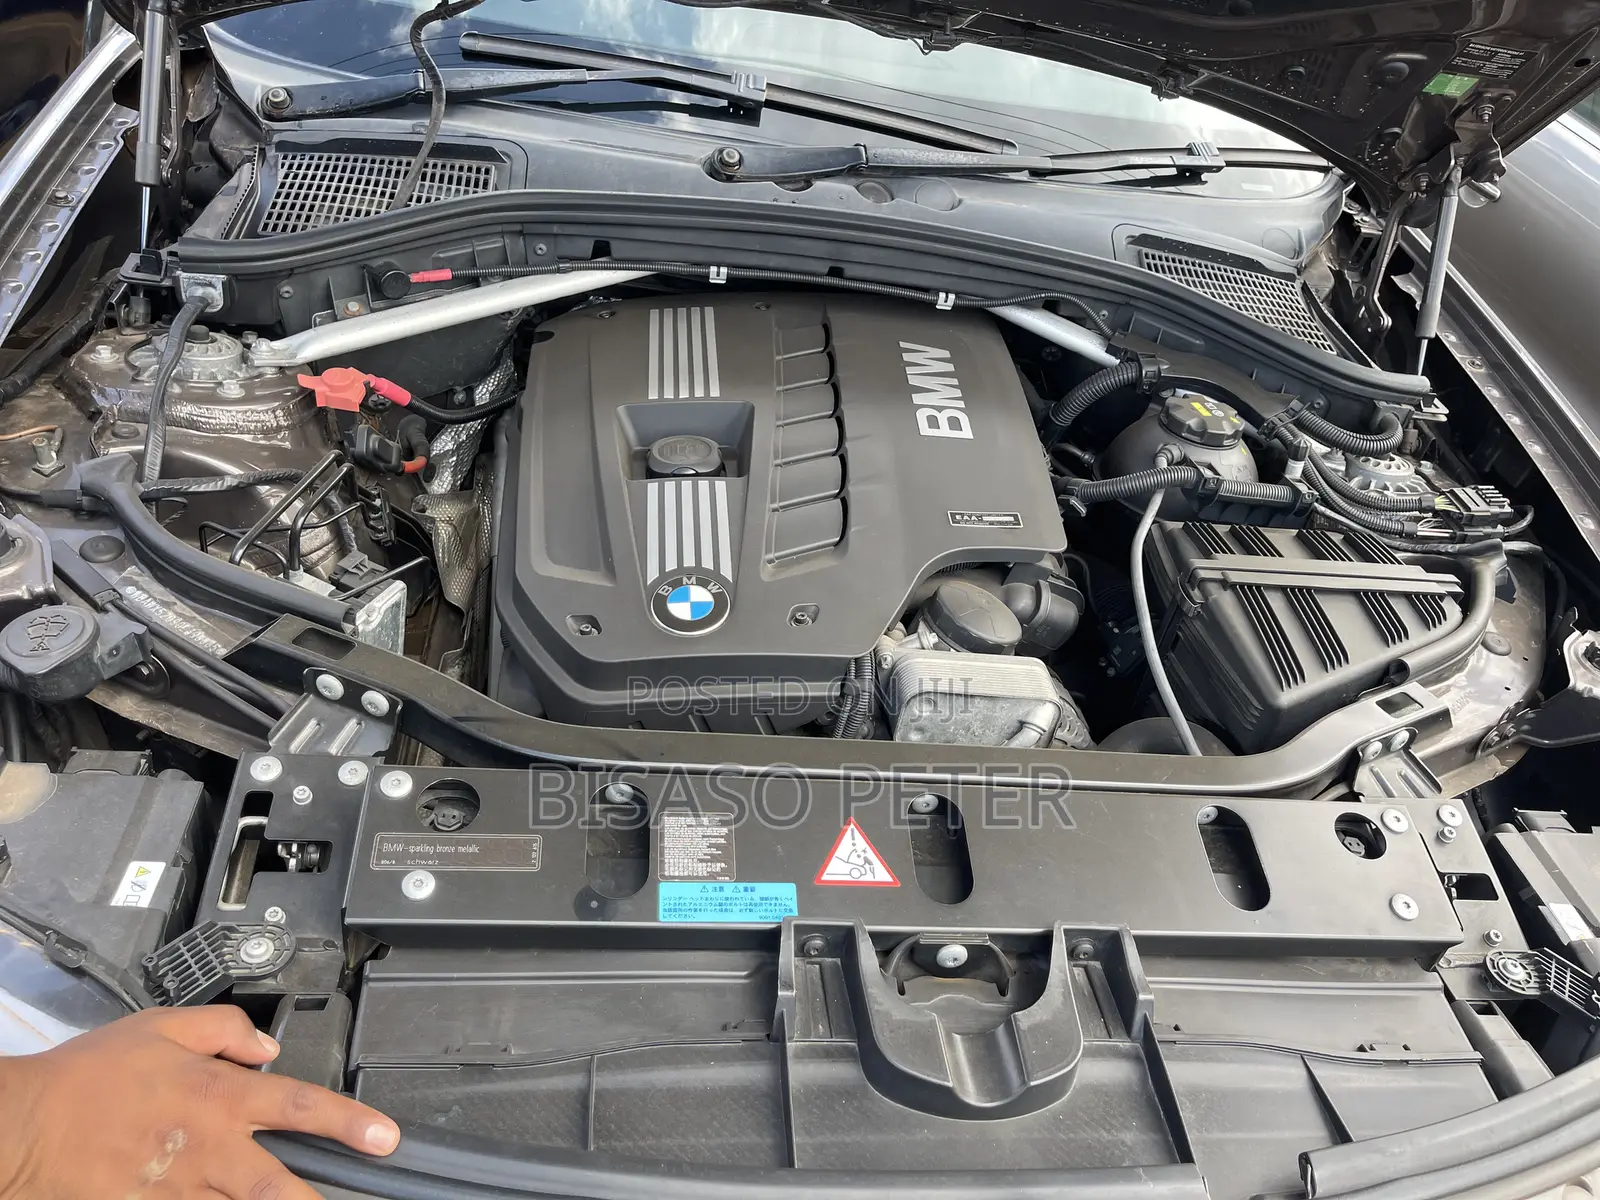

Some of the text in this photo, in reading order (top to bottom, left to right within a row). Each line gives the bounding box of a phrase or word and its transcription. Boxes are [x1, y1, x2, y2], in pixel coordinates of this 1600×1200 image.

[899, 341, 974, 440] BMW
[657, 576, 723, 597] BMW
[436, 844, 456, 853] bronze
[457, 844, 480, 854] metallic
